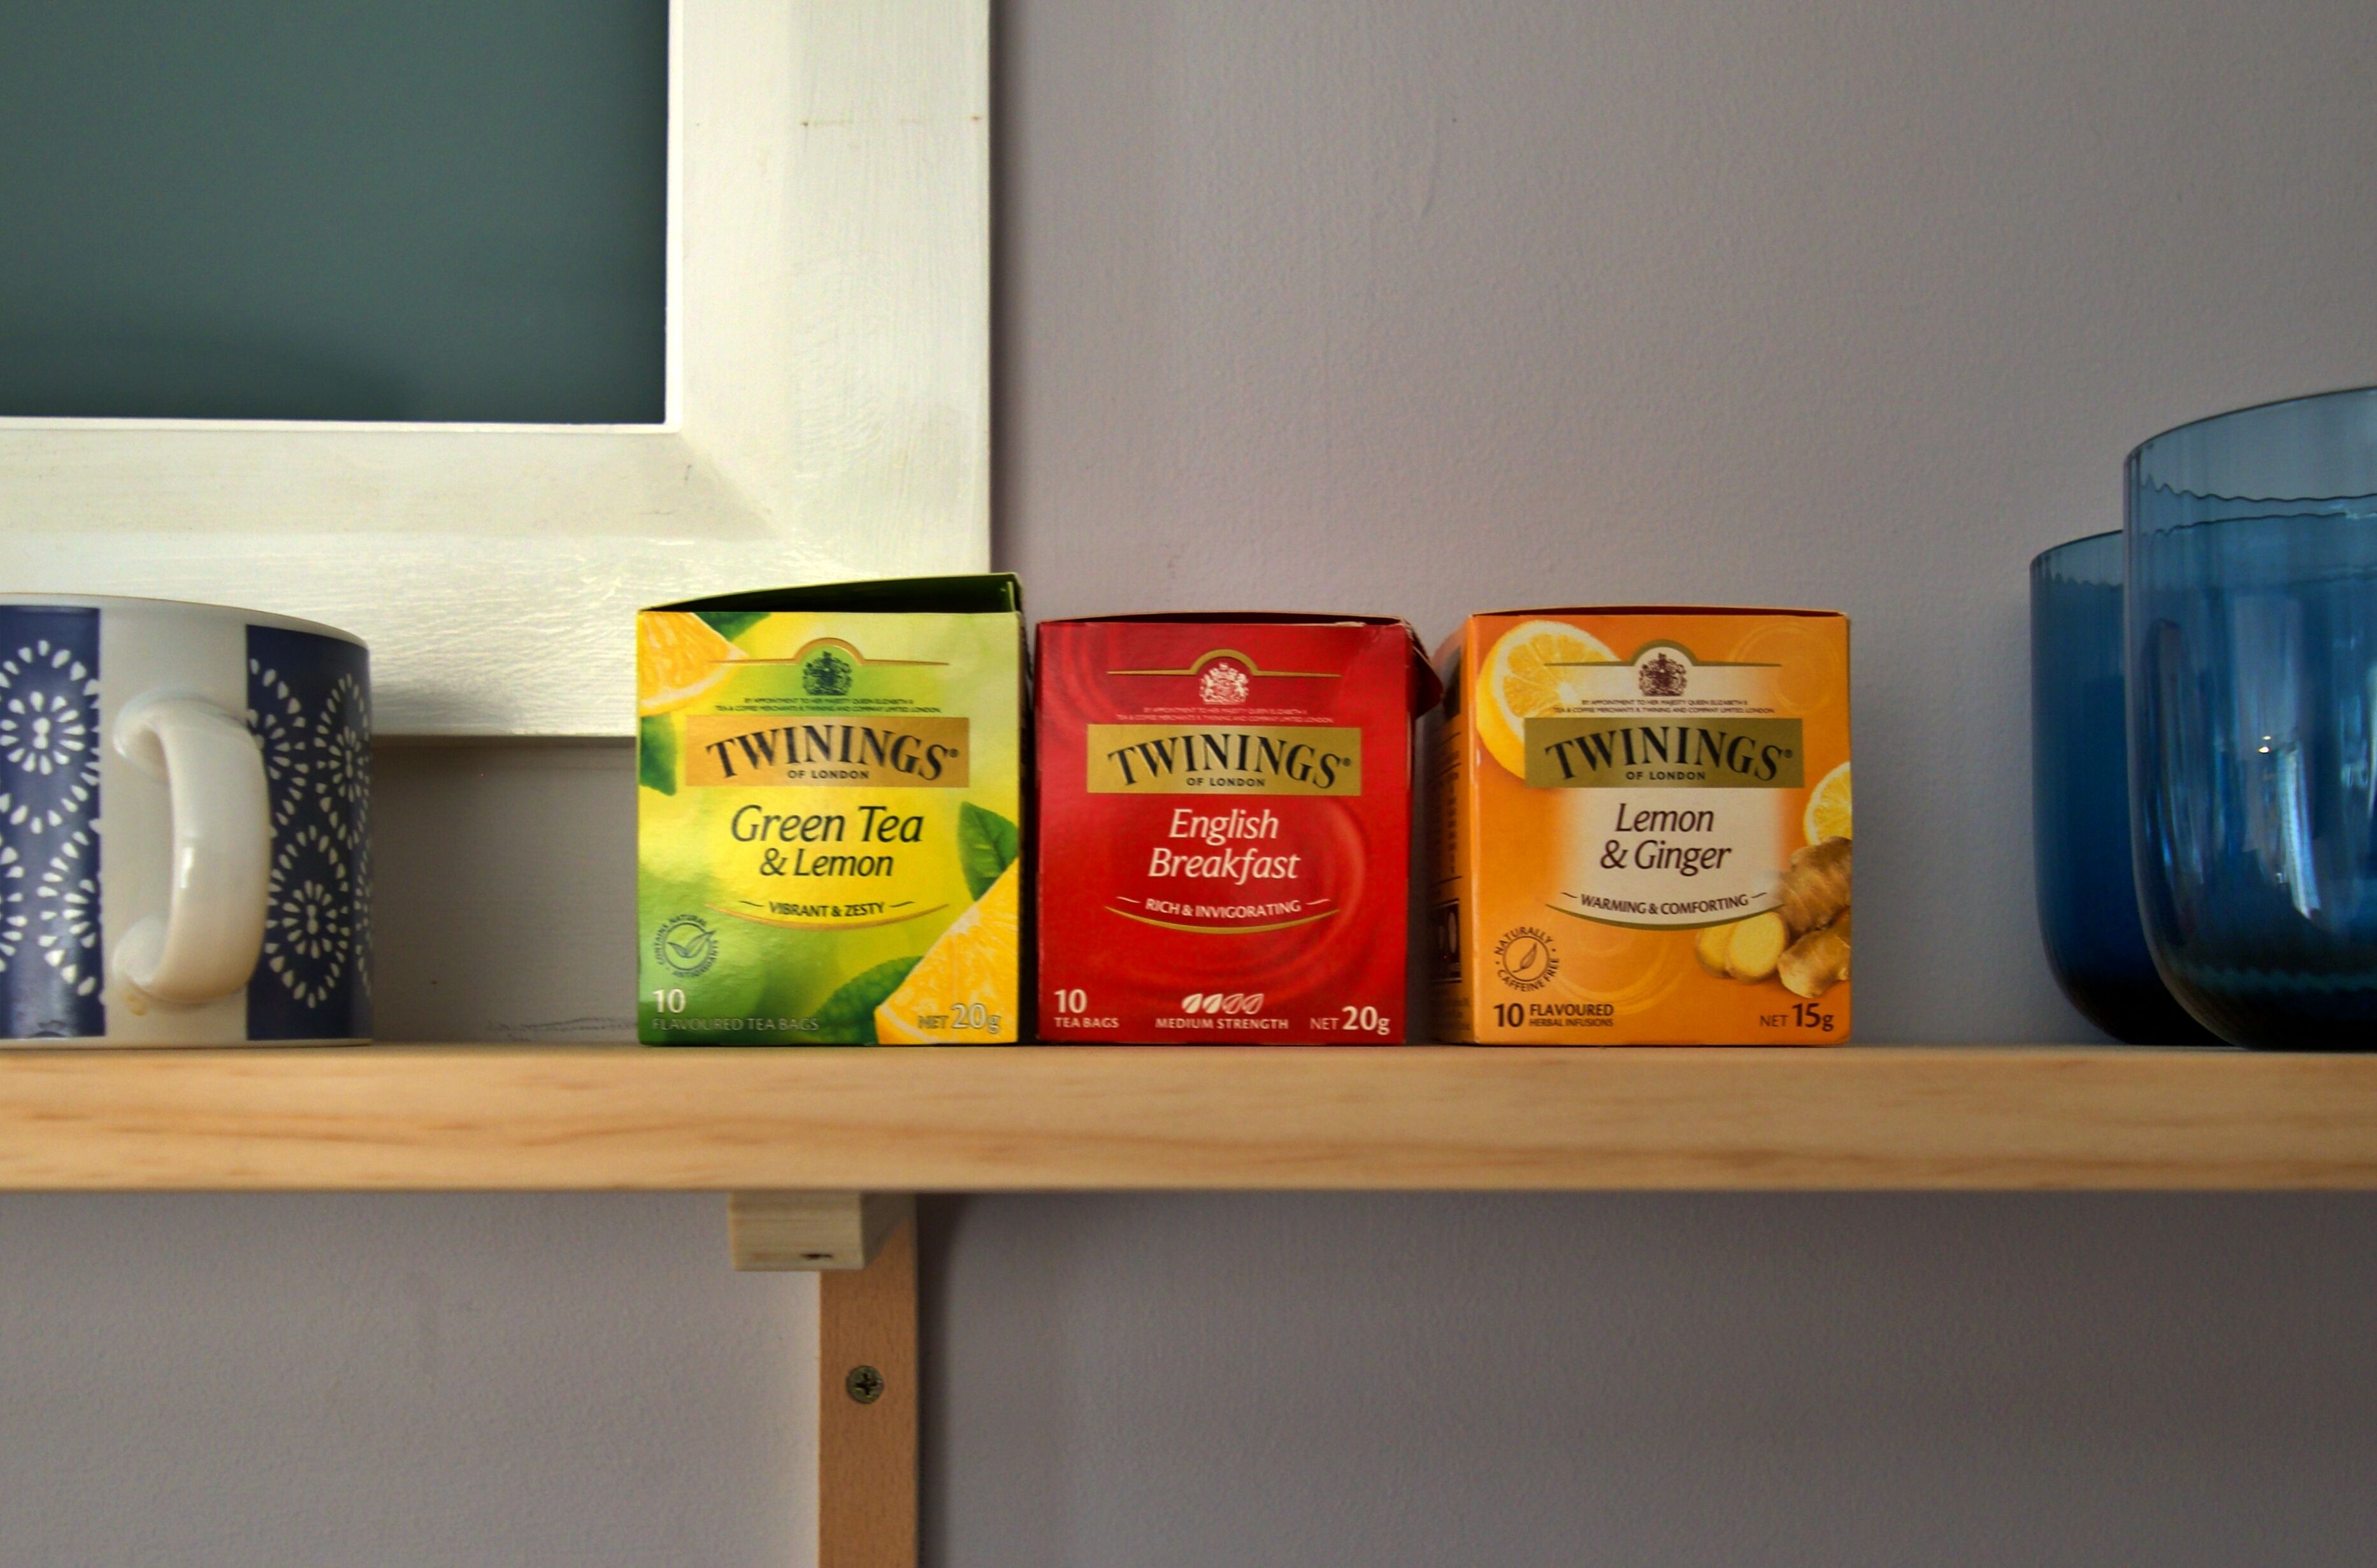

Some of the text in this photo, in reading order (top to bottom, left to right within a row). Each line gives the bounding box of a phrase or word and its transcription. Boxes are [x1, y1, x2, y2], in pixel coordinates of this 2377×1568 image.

[787, 770, 870, 779] OF LONDON
[1186, 777, 1266, 787] OF LONDON
[1625, 771, 1706, 780] OF LONDON
[731, 804, 924, 843] Green Tea
[1168, 808, 1279, 846] English
[1614, 803, 1714, 832] Lemon
[759, 847, 894, 877] & Lemon
[1147, 847, 1302, 886] Breakfast
[1600, 839, 1733, 877] & Ginger
[768, 901, 886, 917] VIBRANT & ZESTY
[1145, 898, 1302, 918] RICH & INVIGORATING
[1581, 893, 1749, 915] WARMING & COMFORTING
[1493, 926, 1560, 992] NATURALLY CAFFEINE FREE
[652, 988, 687, 1014] 10
[1053, 989, 1088, 1014] 10
[1530, 1003, 1615, 1016] FLAVOURED
[652, 1018, 819, 1031] FLAVOURED TEA BAGS
[918, 1002, 1002, 1034] NET 20g
[1053, 1017, 1120, 1028] TEA BAGS
[1154, 1018, 1289, 1030] MEDIUM STRENGTH
[1309, 1005, 1391, 1035] NET 20g
[1493, 1003, 1525, 1028] 10
[1529, 1018, 1614, 1027] HERBAL INFUSIONS
[1760, 1002, 1834, 1032] NET 15g
